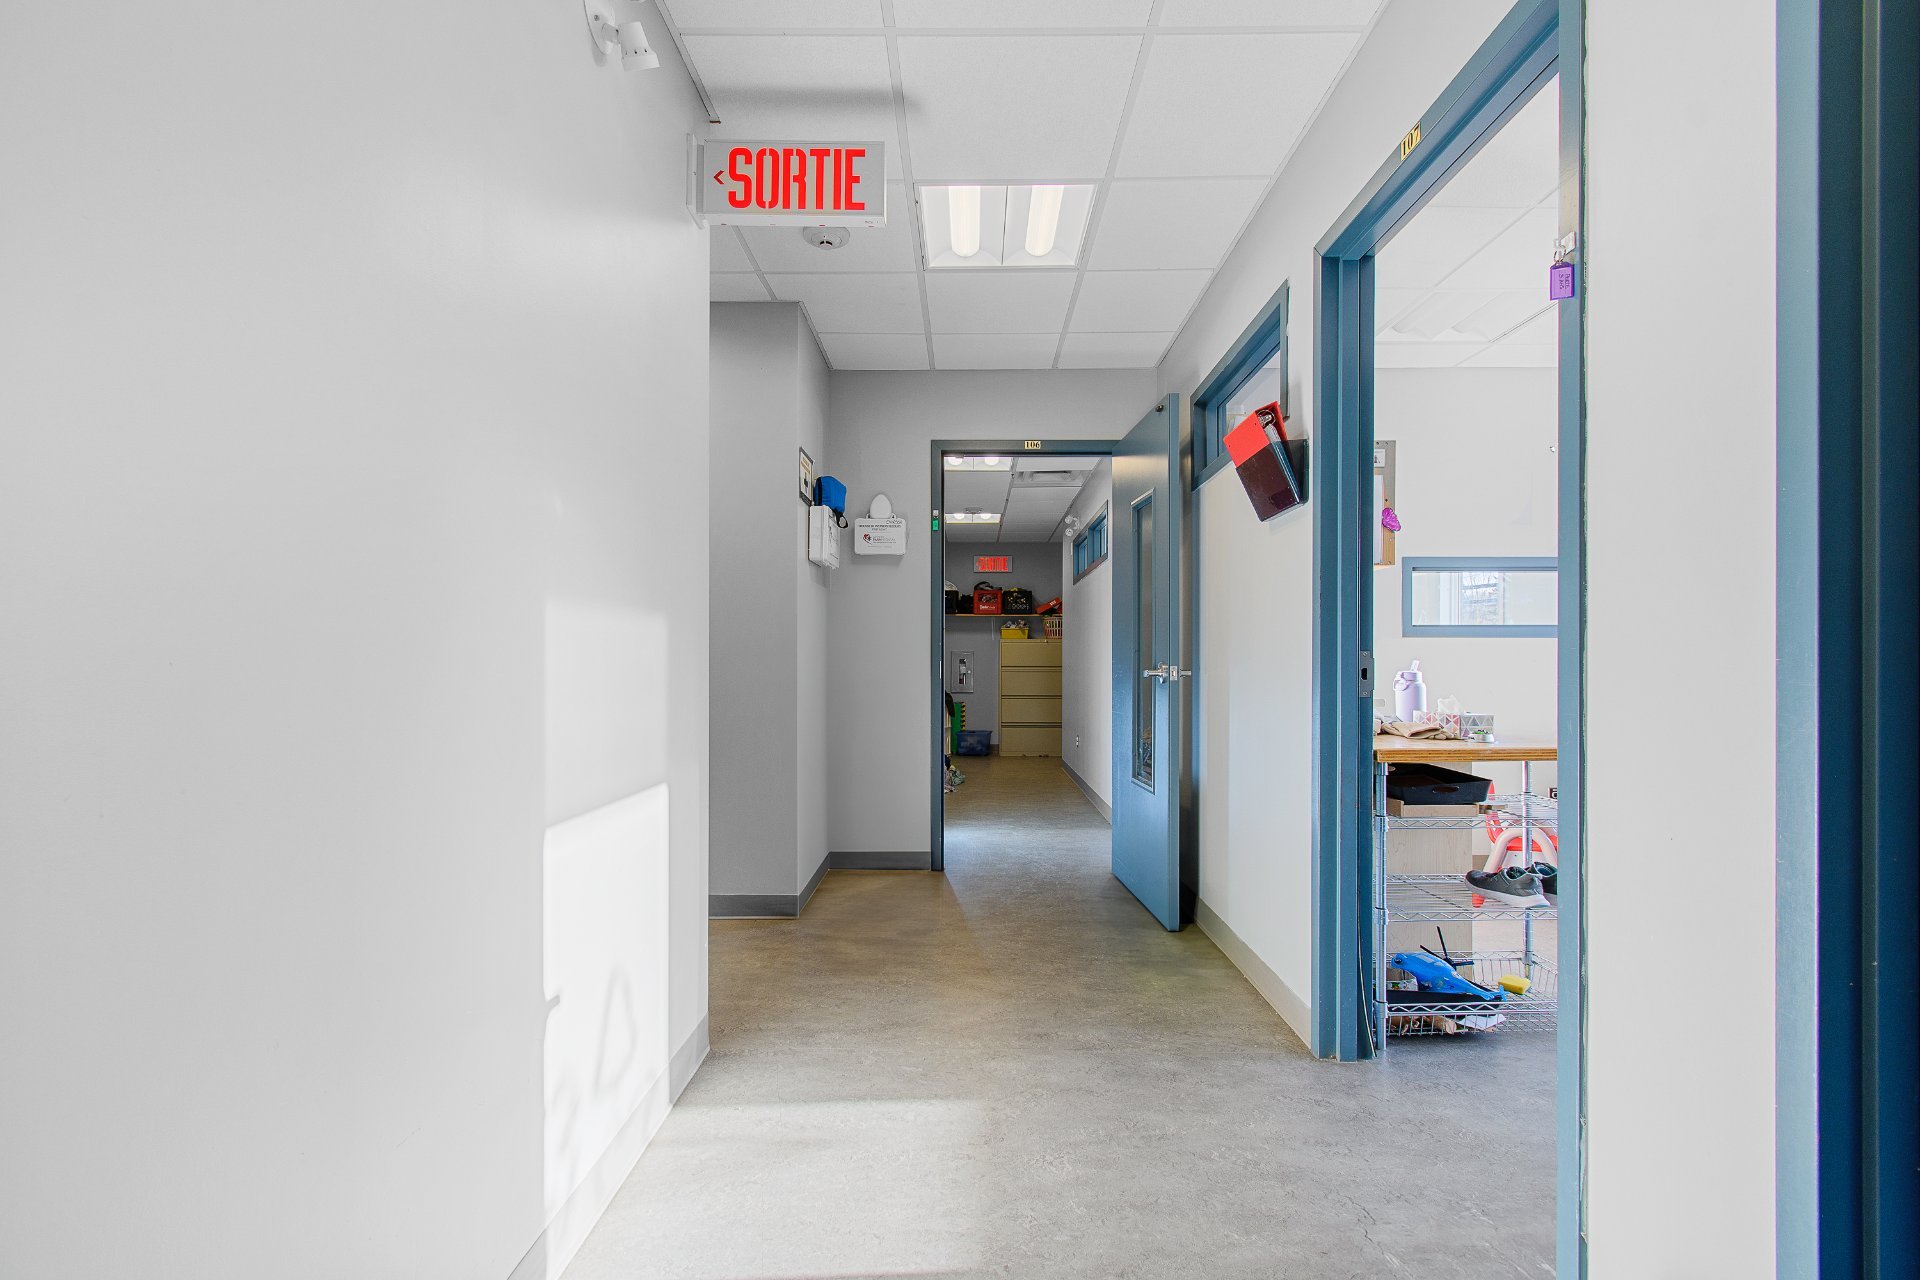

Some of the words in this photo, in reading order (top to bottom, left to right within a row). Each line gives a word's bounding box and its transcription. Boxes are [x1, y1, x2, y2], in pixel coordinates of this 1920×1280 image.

[1402, 123, 1420, 156] 107
[728, 147, 866, 211] SORTIE
[1026, 441, 1040, 449] 106
